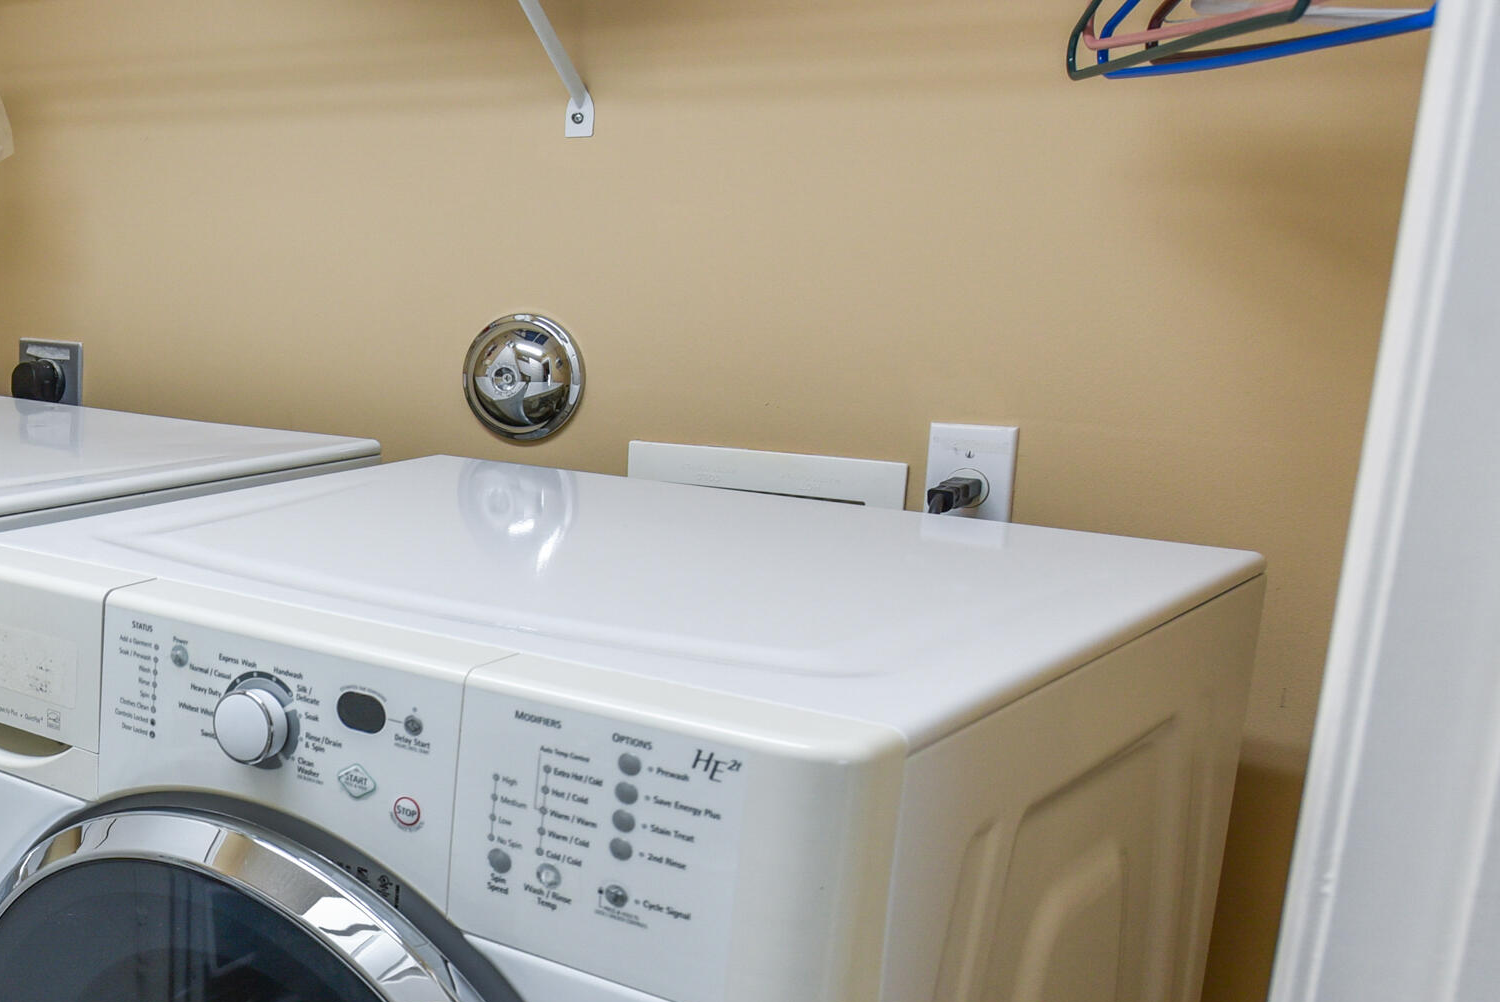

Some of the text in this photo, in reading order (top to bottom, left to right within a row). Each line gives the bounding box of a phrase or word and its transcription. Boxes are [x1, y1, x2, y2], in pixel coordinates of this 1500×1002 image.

[132, 620, 153, 633] STATUS
[219, 653, 257, 669] Express Wash
[189, 663, 209, 675] Normal
[214, 669, 232, 680] Casual
[273, 666, 303, 680] Handwash
[190, 683, 222, 699] Heavy Duty
[296, 684, 308, 693] Silk
[178, 701, 199, 713] Whitest
[296, 693, 320, 706] Delicate
[305, 712, 319, 722] Soak
[514, 709, 562, 729] MODIFIERS
[311, 743, 325, 753] Spin
[394, 734, 431, 749] Delay Start
[612, 732, 653, 751] OPTIONS
[297, 757, 314, 768] Clean
[297, 765, 320, 778] Washer
[553, 767, 570, 779] Extra
[571, 772, 583, 781] Hot
[588, 776, 603, 787] Cold
[656, 766, 690, 782] Prewash
[344, 773, 368, 786] START
[502, 775, 517, 787] High
[500, 795, 527, 809] Medium
[551, 788, 565, 799] Hot
[571, 793, 589, 805] Cold
[396, 805, 417, 819] STOP
[653, 795, 722, 820] Save Energy Plus
[498, 816, 512, 826] Low
[549, 809, 570, 821] Warm
[576, 817, 598, 828] Warm
[547, 830, 569, 841] Warm
[574, 837, 590, 848] Cold
[650, 824, 695, 843] Stain Treat
[497, 836, 522, 850] No Spin
[546, 850, 561, 861] Cold
[566, 856, 582, 867] Cold
[647, 853, 687, 870] 2nd Rinse
[490, 872, 506, 885] Spin
[487, 881, 509, 895] Speed
[523, 882, 545, 896] Wash
[551, 891, 572, 905] Rinse
[537, 896, 557, 911] Temp
[642, 900, 692, 921] Cycle Signal
